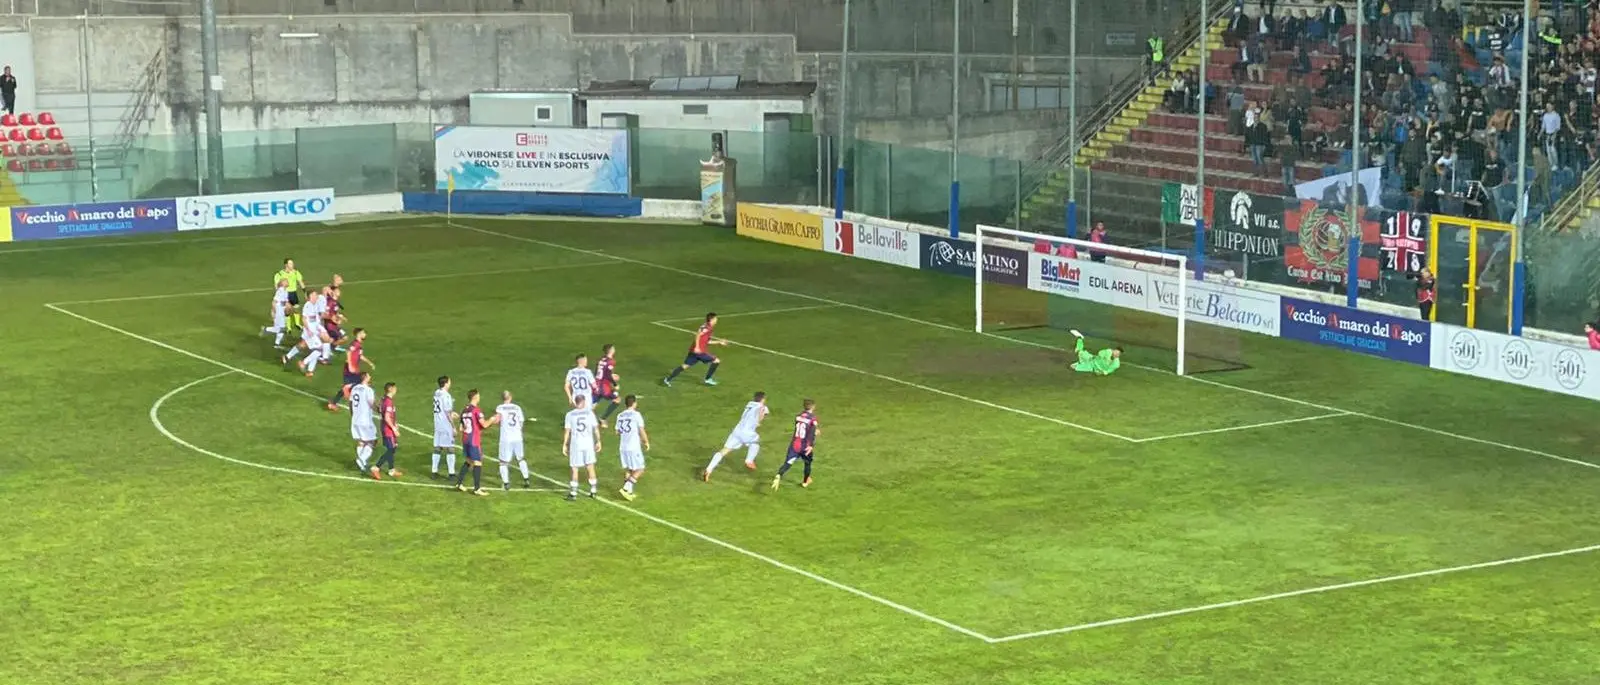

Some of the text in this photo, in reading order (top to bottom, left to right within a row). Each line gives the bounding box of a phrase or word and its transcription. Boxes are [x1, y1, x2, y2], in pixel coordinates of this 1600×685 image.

[502, 160, 514, 168] SU
[516, 160, 551, 168] ELEVEN
[559, 152, 610, 160] ESCLUSIVA
[16, 211, 65, 225] Vecchio
[68, 208, 113, 221] Amaro
[116, 207, 135, 219] del
[858, 225, 908, 251] Bellaville
[1214, 229, 1279, 256] HIPPONION
[1041, 258, 1081, 280] BigMat
[1089, 276, 1144, 296] EDIL ARENA
[1206, 294, 1262, 327] Belcaro
[1263, 317, 1274, 329] srl
[1285, 303, 1327, 326] Vecchio
[1328, 312, 1371, 334] Amaro
[1372, 321, 1390, 338] del
[1454, 341, 1476, 359] 501
[1506, 350, 1528, 369] 501
[1558, 360, 1580, 379] 501
[353, 393, 360, 407] 9
[508, 411, 517, 427] 3
[576, 416, 586, 432] 5
